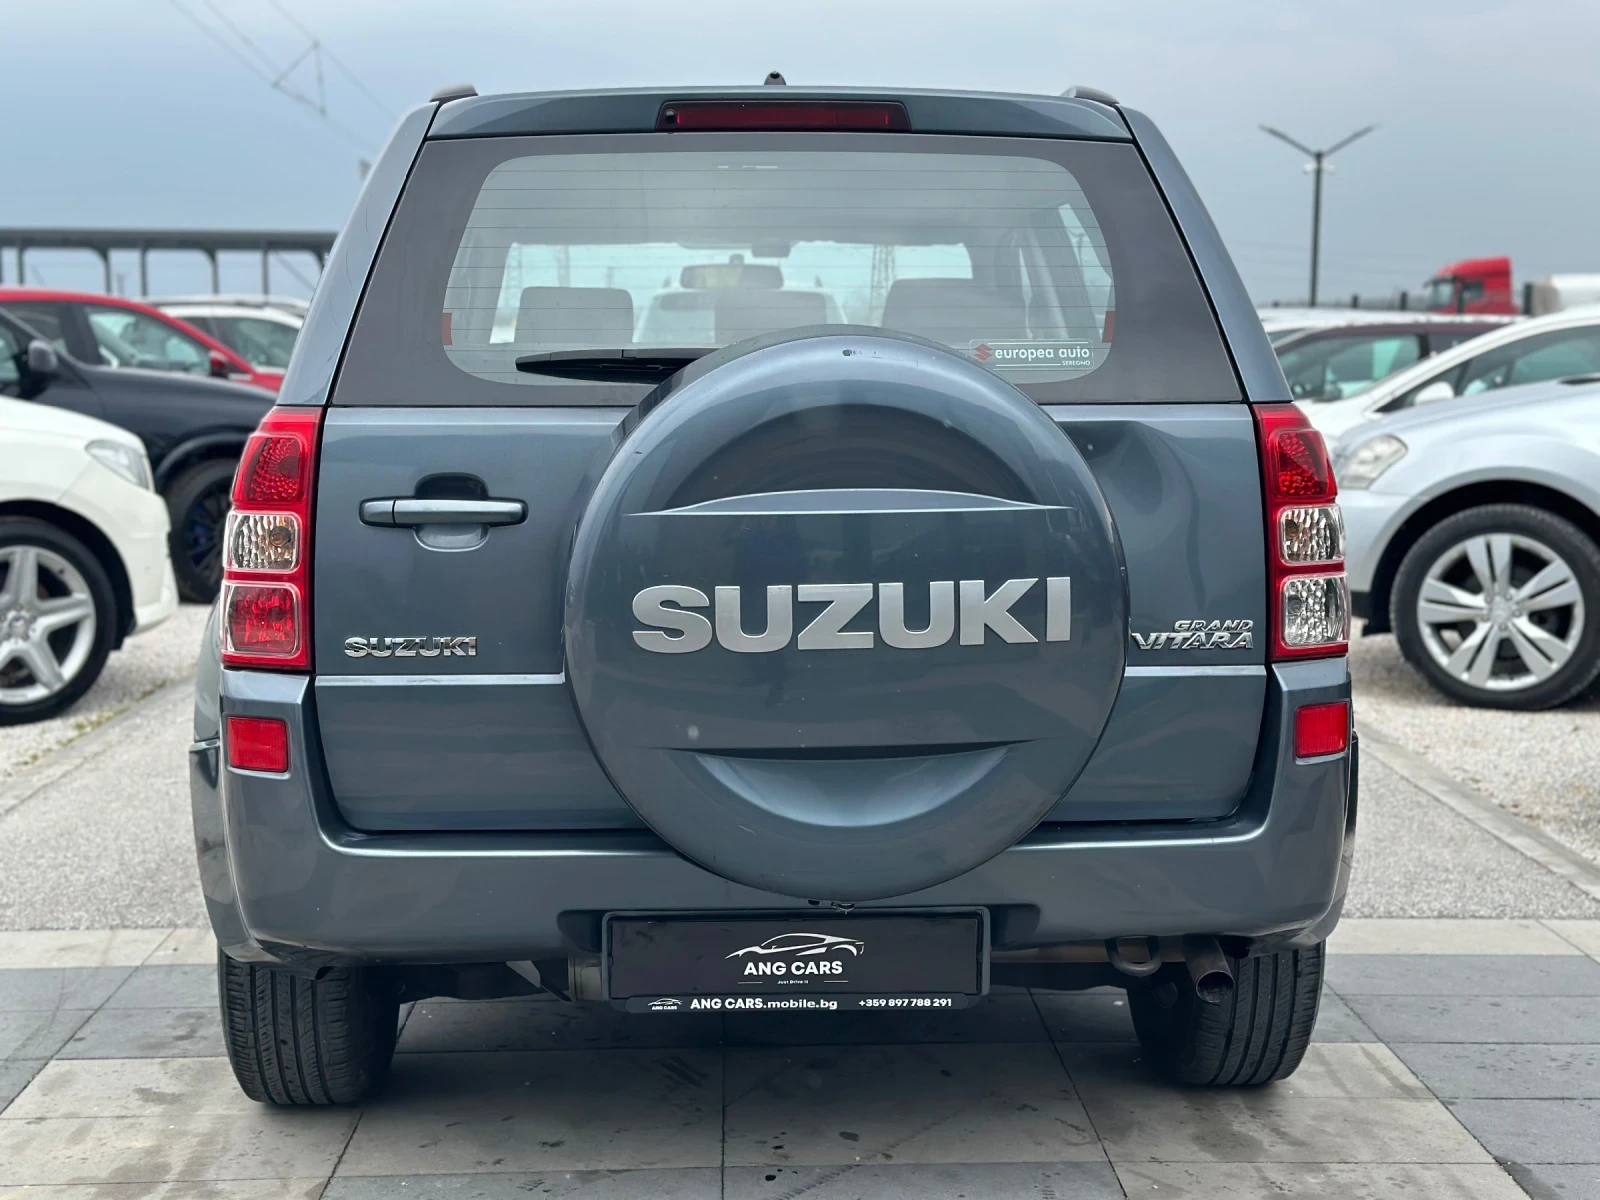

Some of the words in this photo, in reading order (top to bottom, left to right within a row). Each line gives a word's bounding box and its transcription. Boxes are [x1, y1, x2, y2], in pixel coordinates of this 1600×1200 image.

[995, 348, 1054, 361] europea
[1058, 346, 1090, 358] auto
[632, 577, 1071, 653] SUZUKI
[1174, 620, 1254, 632] GRAND
[344, 636, 477, 658] SUZUKI
[1131, 632, 1254, 650] VITARA
[743, 961, 787, 976] ANG
[790, 960, 843, 975] CARS
[690, 998, 722, 1010] ANG
[724, 998, 838, 1010] CARS.mobile.bg
[858, 998, 887, 1007] +359
[888, 998, 909, 1007] 897
[910, 998, 931, 1007] 788
[932, 998, 952, 1007] 291
